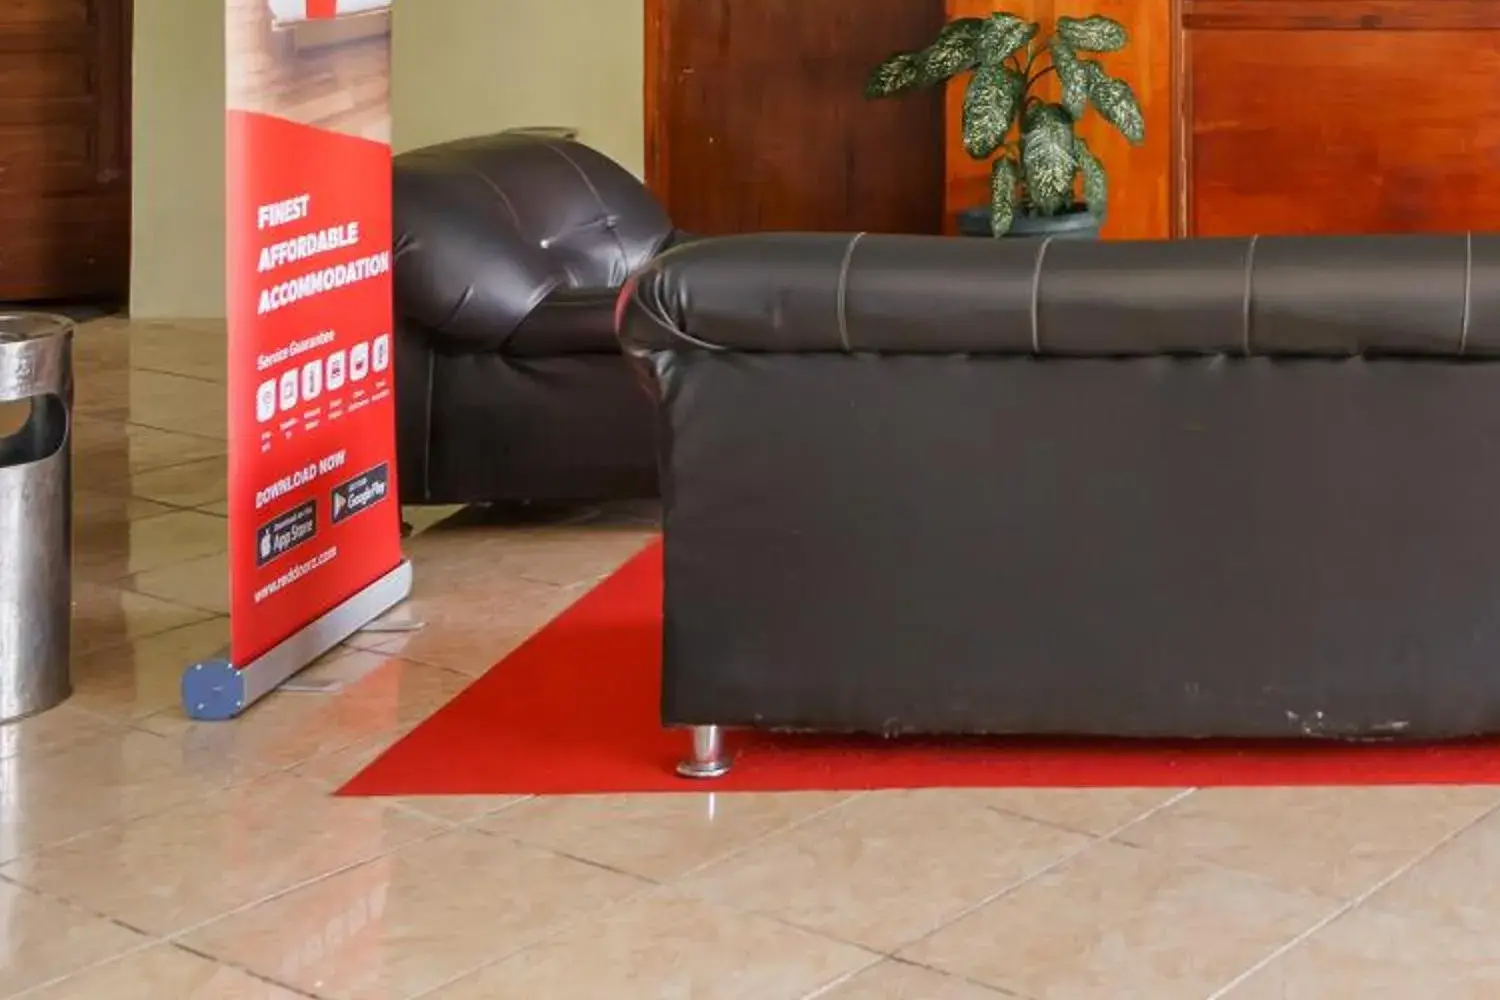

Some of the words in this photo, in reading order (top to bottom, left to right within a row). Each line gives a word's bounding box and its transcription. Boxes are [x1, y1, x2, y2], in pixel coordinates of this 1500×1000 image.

[258, 194, 310, 230] FINEST
[258, 221, 359, 272] AFFORDABLE
[257, 251, 389, 315] ACCOMMODATION
[255, 463, 317, 509] DOWNLOAD
[319, 450, 346, 475] NOW
[273, 533, 291, 551] App
[291, 520, 313, 540] Store
